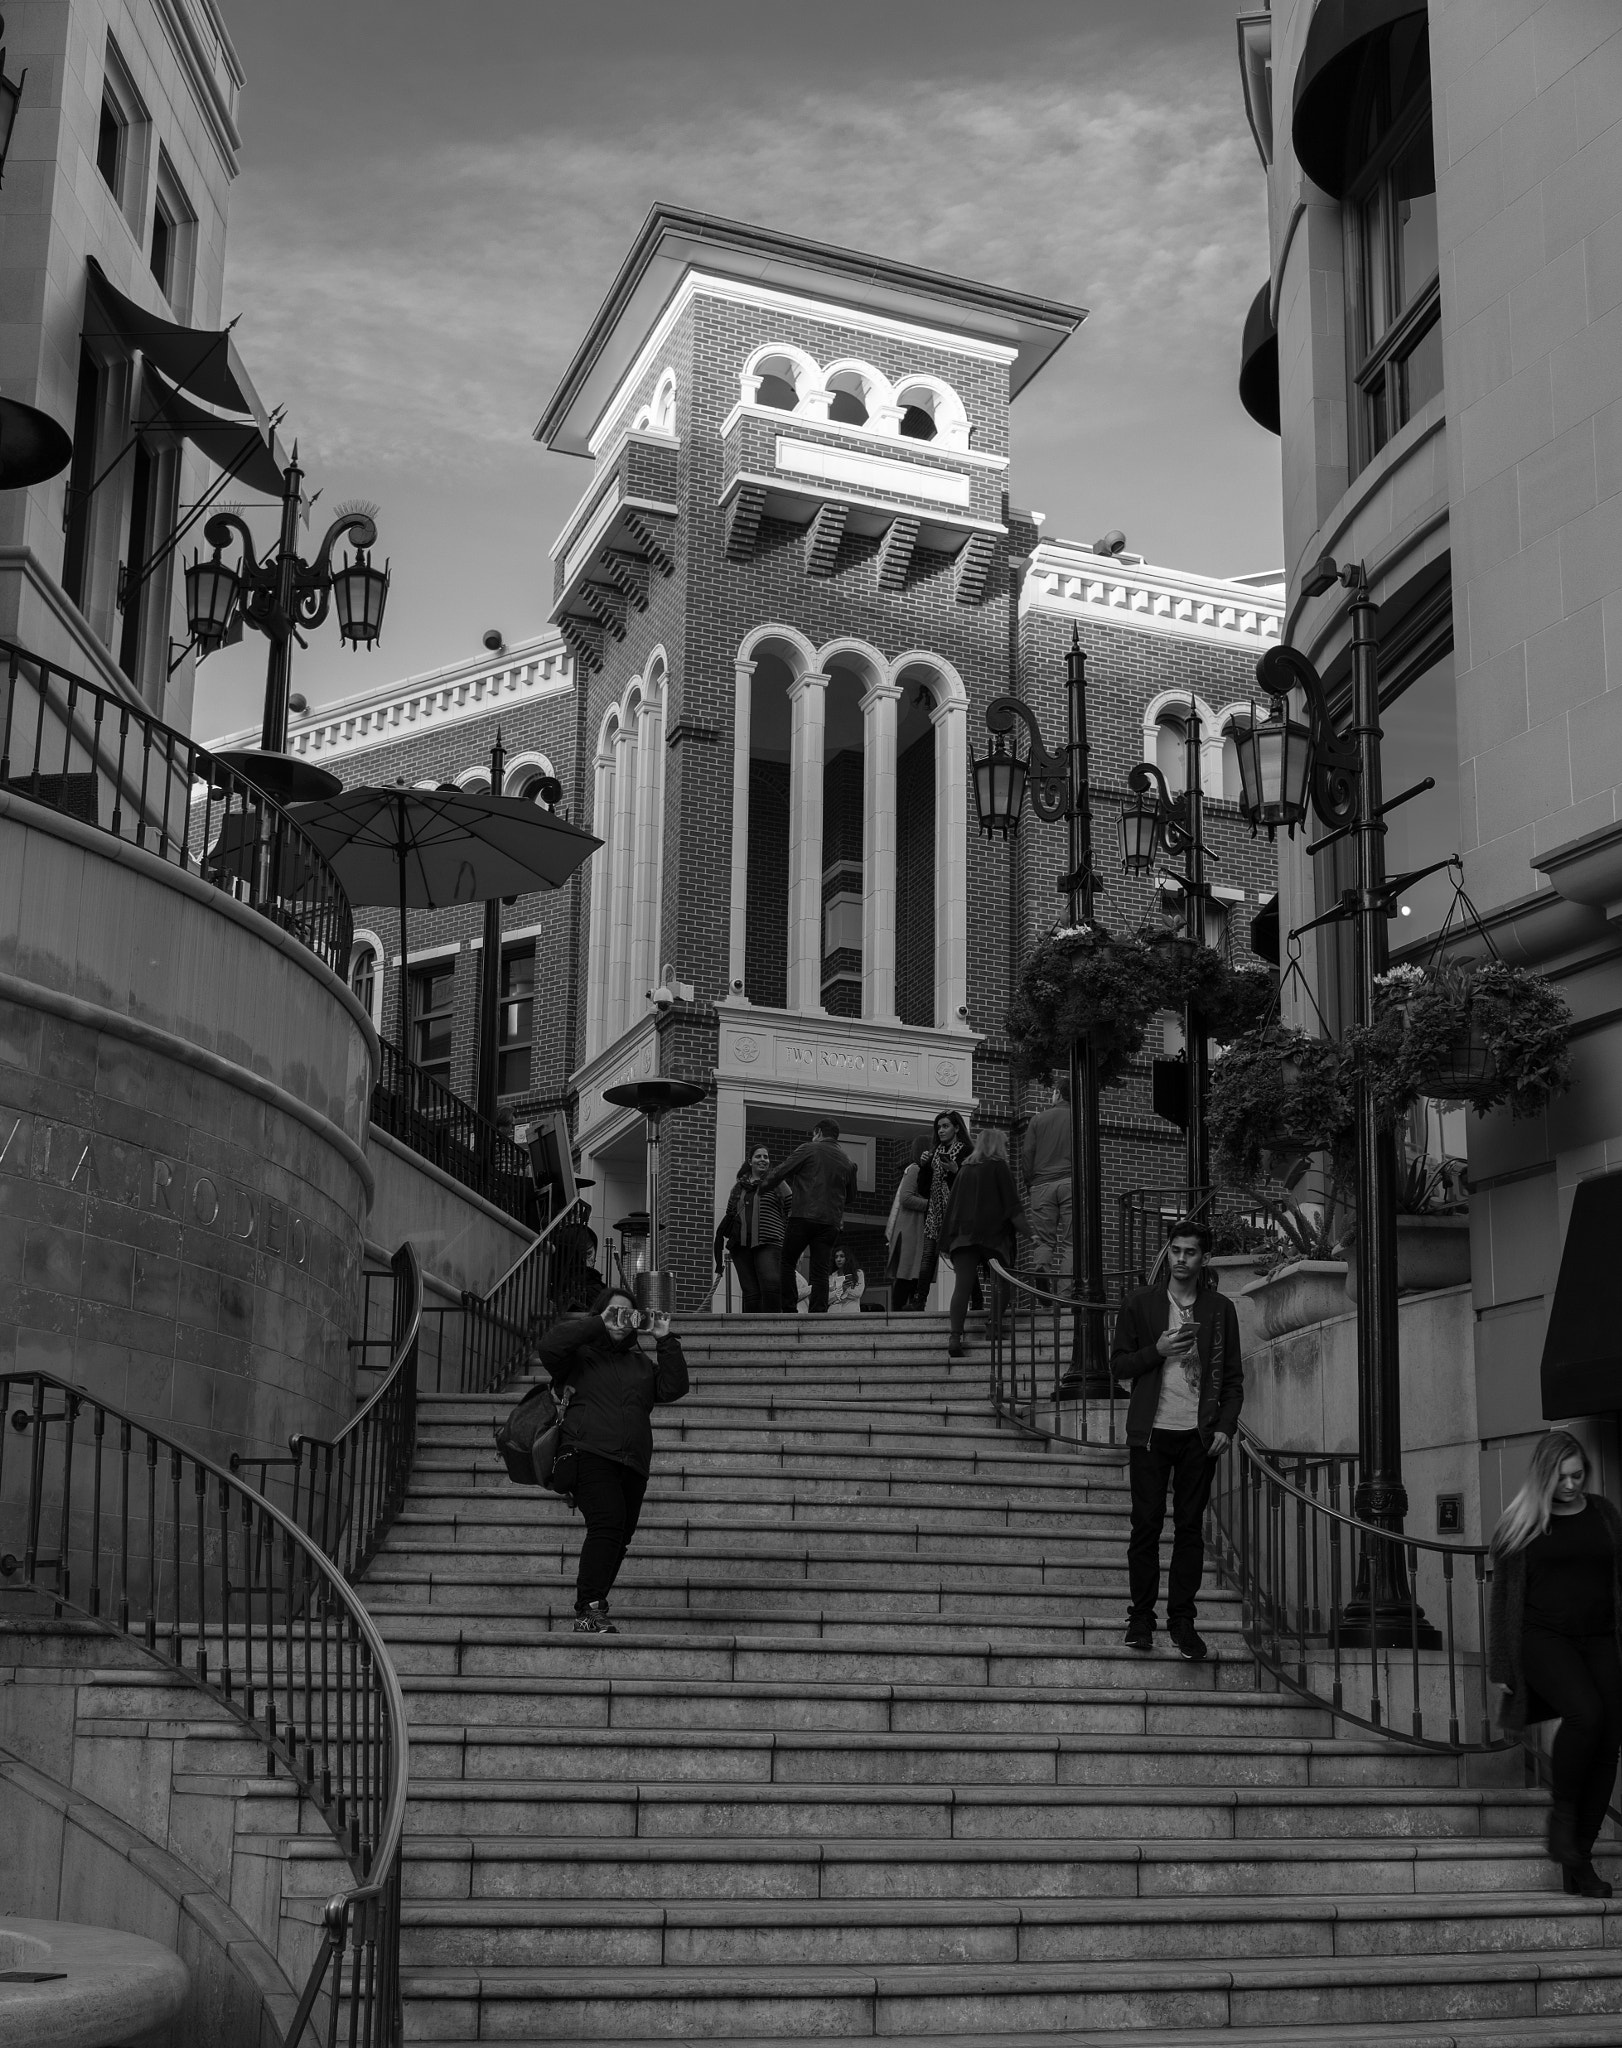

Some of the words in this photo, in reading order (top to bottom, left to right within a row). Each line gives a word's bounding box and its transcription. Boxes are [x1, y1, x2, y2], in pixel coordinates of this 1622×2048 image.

[786, 1047, 813, 1065] TWO
[820, 1051, 865, 1070] RODEO
[872, 1057, 909, 1076] DRIVE
[150, 1159, 307, 1264] RODEO
